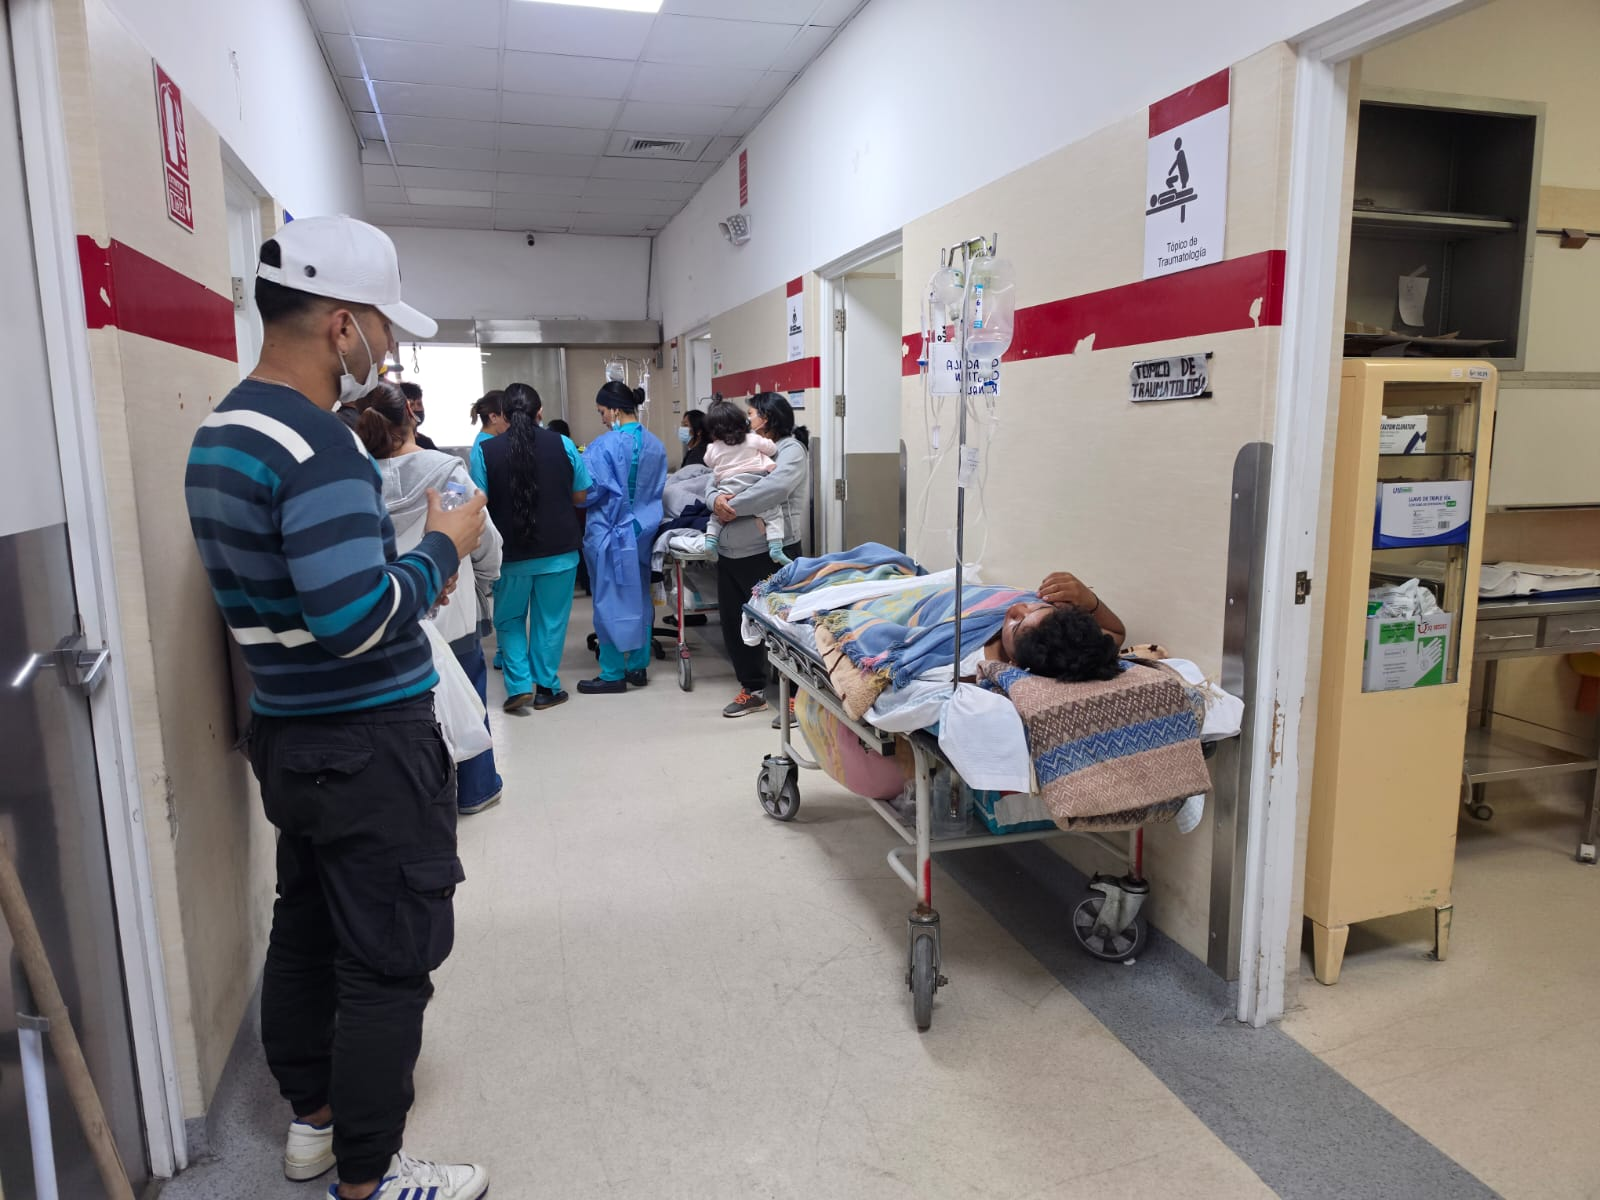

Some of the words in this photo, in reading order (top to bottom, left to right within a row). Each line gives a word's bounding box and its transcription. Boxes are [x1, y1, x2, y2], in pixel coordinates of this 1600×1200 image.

[1167, 240, 1188, 253] Tópico
[1189, 236, 1198, 247] de
[1157, 247, 1206, 268] Traumatología
[1181, 357, 1196, 377] DE
